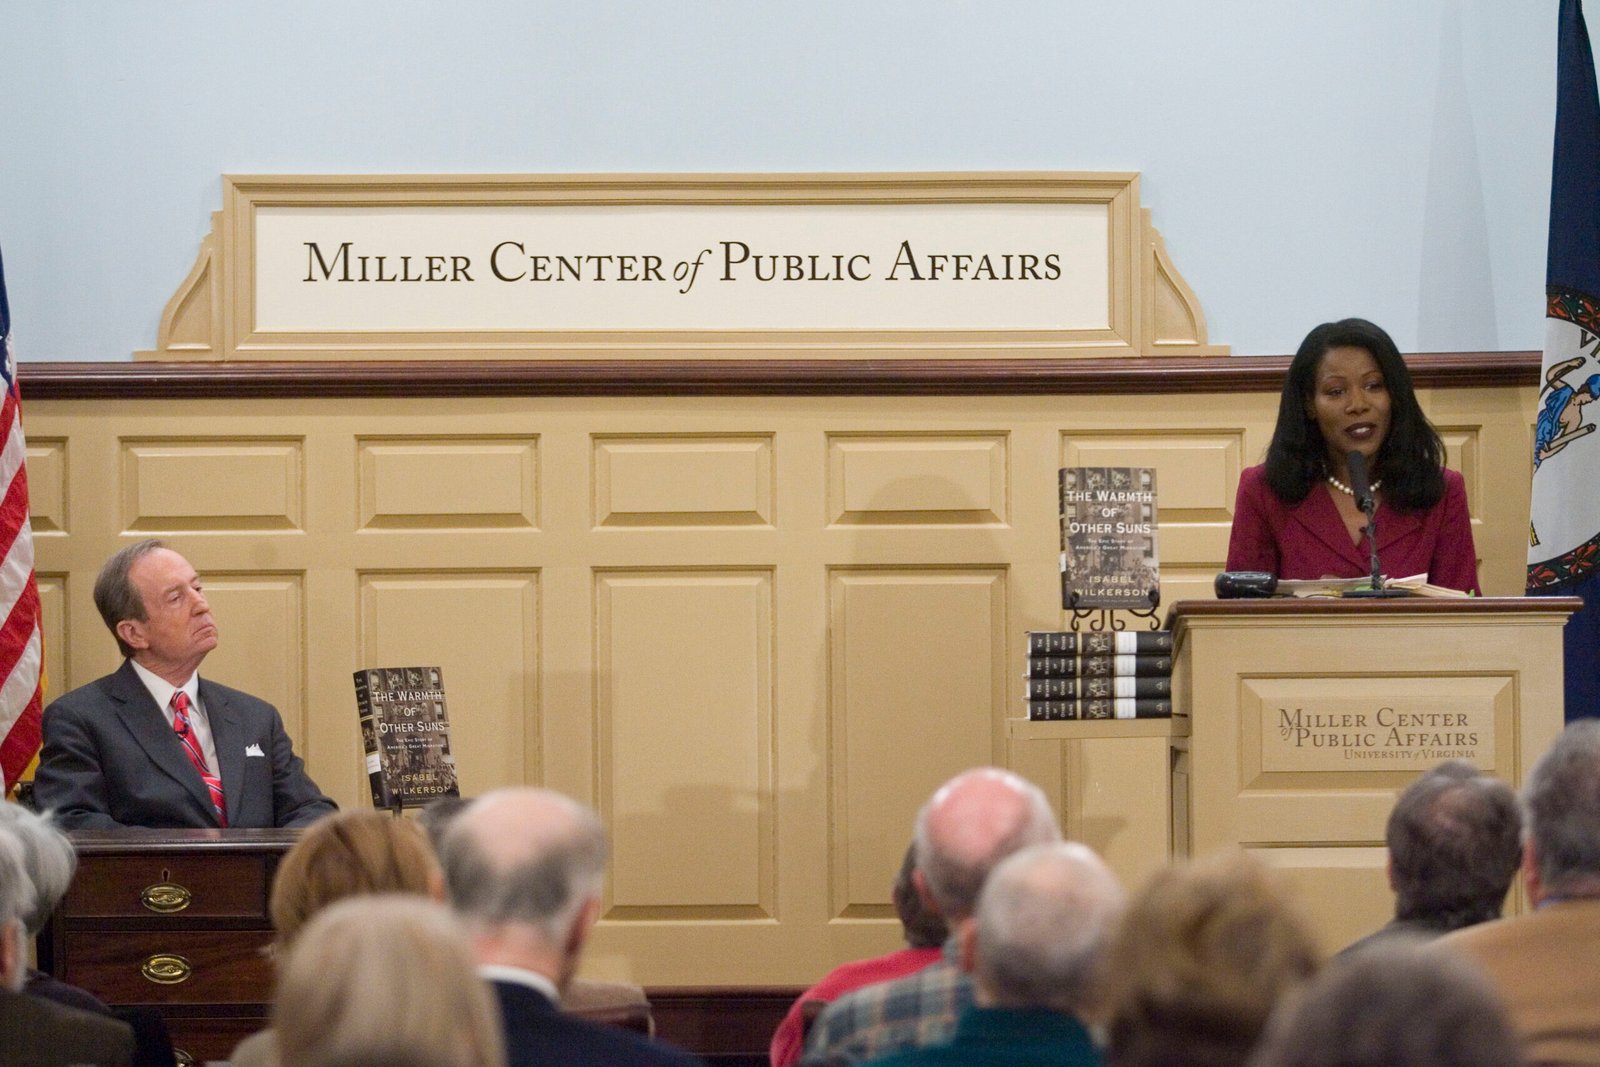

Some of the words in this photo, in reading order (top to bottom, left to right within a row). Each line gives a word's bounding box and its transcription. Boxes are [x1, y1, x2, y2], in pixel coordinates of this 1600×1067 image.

[302, 242, 475, 283] MILLER
[489, 240, 667, 283] CENTER
[672, 248, 713, 295] of
[719, 241, 872, 282] PUBLIC
[884, 239, 1062, 281] AFFAIRS
[1067, 491, 1092, 502] THE
[1096, 490, 1152, 502] WARMTH
[1102, 508, 1118, 518] OF
[1070, 522, 1112, 534] OTHER
[1116, 522, 1151, 534] SUNS
[1089, 575, 1135, 583] ISABEL
[1074, 588, 1149, 597] WILKERSON
[373, 691, 394, 702] THE
[397, 690, 442, 702] WARMTH
[404, 707, 416, 717] OF
[1278, 708, 1367, 728] MILLER
[1376, 707, 1469, 727] CENTER
[380, 722, 414, 734] OTHER
[416, 721, 445, 732] SUNS
[1280, 727, 1294, 741] of
[1295, 727, 1376, 747] PUBLIC
[1385, 727, 1478, 747] AFFAIRS
[1344, 749, 1413, 760] UNIVERSITY
[1421, 749, 1476, 759] VIRGINIA
[401, 773, 438, 782] ISABEL
